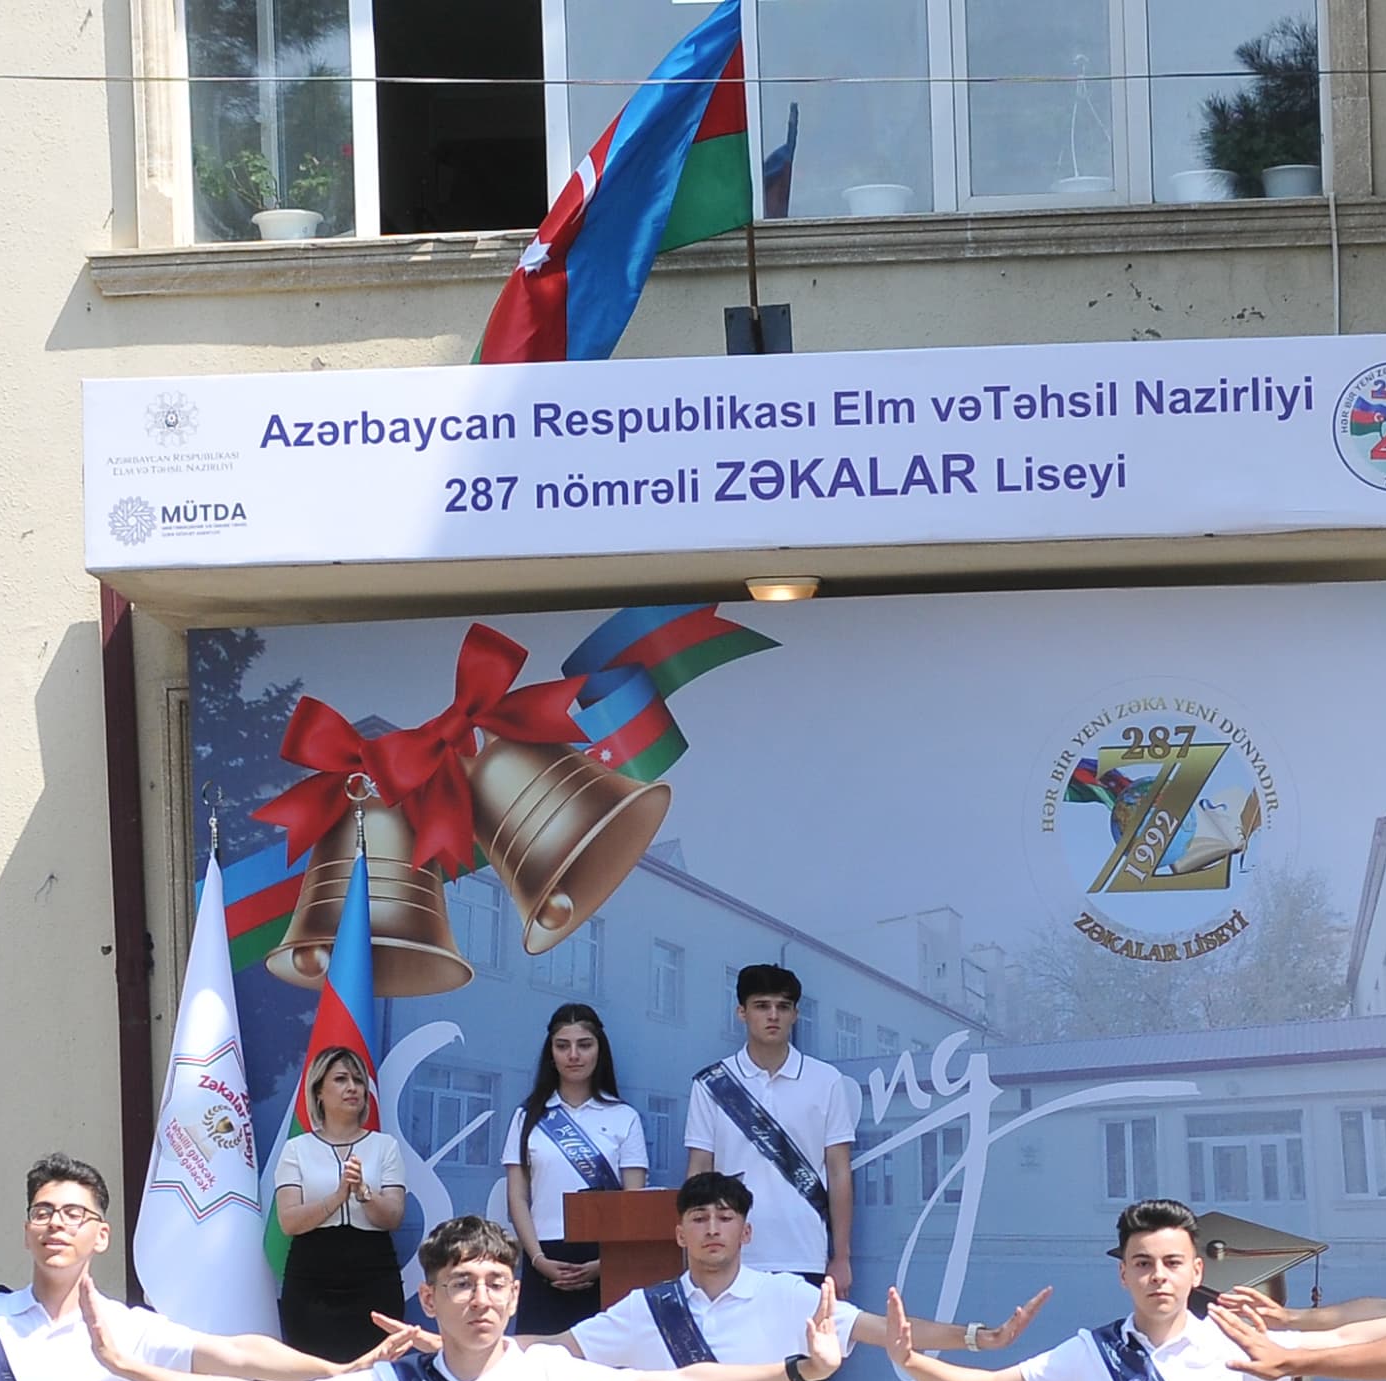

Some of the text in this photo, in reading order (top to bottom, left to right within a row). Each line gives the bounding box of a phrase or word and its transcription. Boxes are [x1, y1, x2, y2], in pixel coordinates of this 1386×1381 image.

[259, 410, 516, 452] Azərbaycan
[532, 396, 818, 449] Respublikası
[833, 390, 915, 426] Elm
[930, 381, 1117, 422] vəTəhsil
[1135, 375, 1313, 421] Nazirliyi
[445, 453, 1126, 513] 287 nömrəli ZƏKALAR Liseyi
[161, 499, 247, 524] MÜTDA
[1122, 726, 1197, 760] 287
[1123, 811, 1179, 882] 1992
[1074, 909, 1250, 963] ZƏKALAR LİSEYİ
[198, 1074, 247, 1119] Zəkalar
